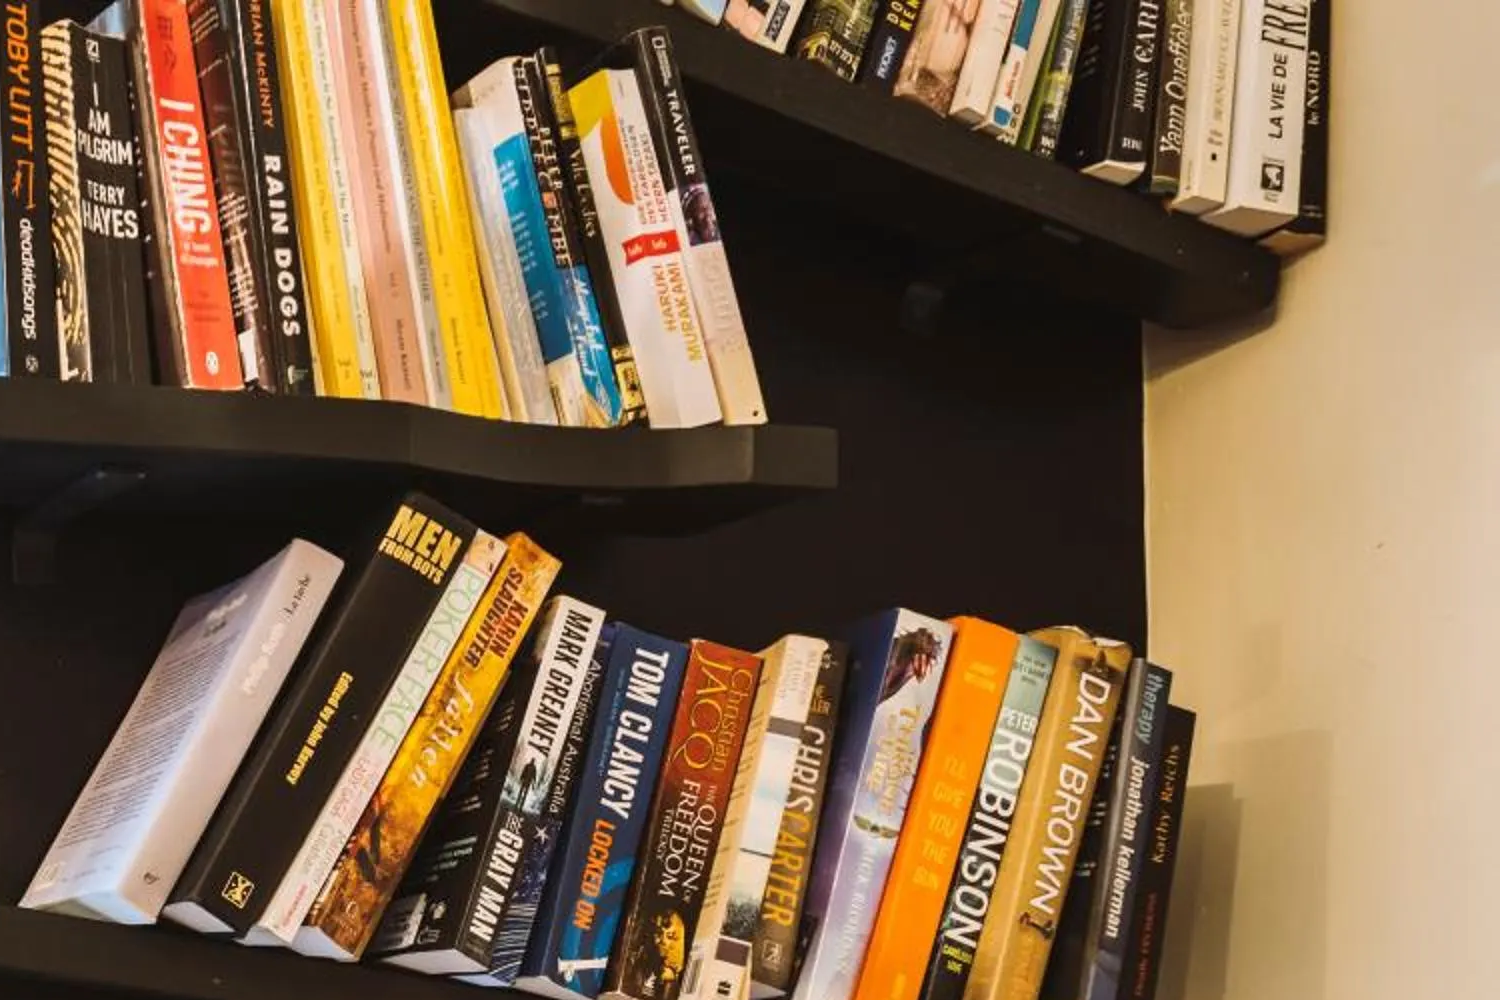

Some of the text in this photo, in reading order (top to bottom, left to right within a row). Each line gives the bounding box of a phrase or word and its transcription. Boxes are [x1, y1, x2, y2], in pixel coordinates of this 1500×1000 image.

[6, 3, 33, 152] TOBY LITT
[88, 108, 111, 136] AM
[92, 81, 99, 107] I
[159, 98, 195, 112] I
[1268, 53, 1288, 140] LA VIE DE
[1307, 51, 1320, 110] NORD
[77, 128, 133, 166] PILGRIM
[163, 120, 212, 233] CHING
[666, 89, 695, 176] TRAVELER
[1160, 104, 1186, 155] Yann
[81, 200, 138, 239] HAYES
[87, 180, 125, 205] TERRY
[19, 218, 37, 340] deadkidsongs
[263, 154, 301, 337] RAIN DOGS
[652, 265, 677, 332] HARUKI
[668, 262, 702, 361] MURAKAMI
[378, 538, 446, 586] FROM BOYS
[385, 504, 463, 571] MEN
[372, 566, 485, 748] POKER FACE
[464, 566, 524, 669] SLAUGHTER
[489, 600, 529, 660] KARIN
[527, 609, 593, 758] MARK GREANEY
[625, 647, 670, 707] TOM
[671, 648, 733, 769] JACQ
[713, 667, 754, 771] Christian
[411, 671, 474, 788] fallen
[549, 660, 603, 813] Aboriginal Australia
[600, 709, 653, 820] CLANCY
[785, 724, 826, 813] CHRIS
[658, 778, 701, 897] FREEDOM
[943, 727, 1034, 949] ROBINSON
[1030, 671, 1112, 915] DAN BROWN
[1104, 674, 1164, 938] therapy jonathan kellerman
[469, 828, 524, 942] GRAY MAN
[572, 819, 617, 931] LOCKED ON
[684, 804, 717, 891] QUEEN
[761, 811, 814, 927] CARTER
